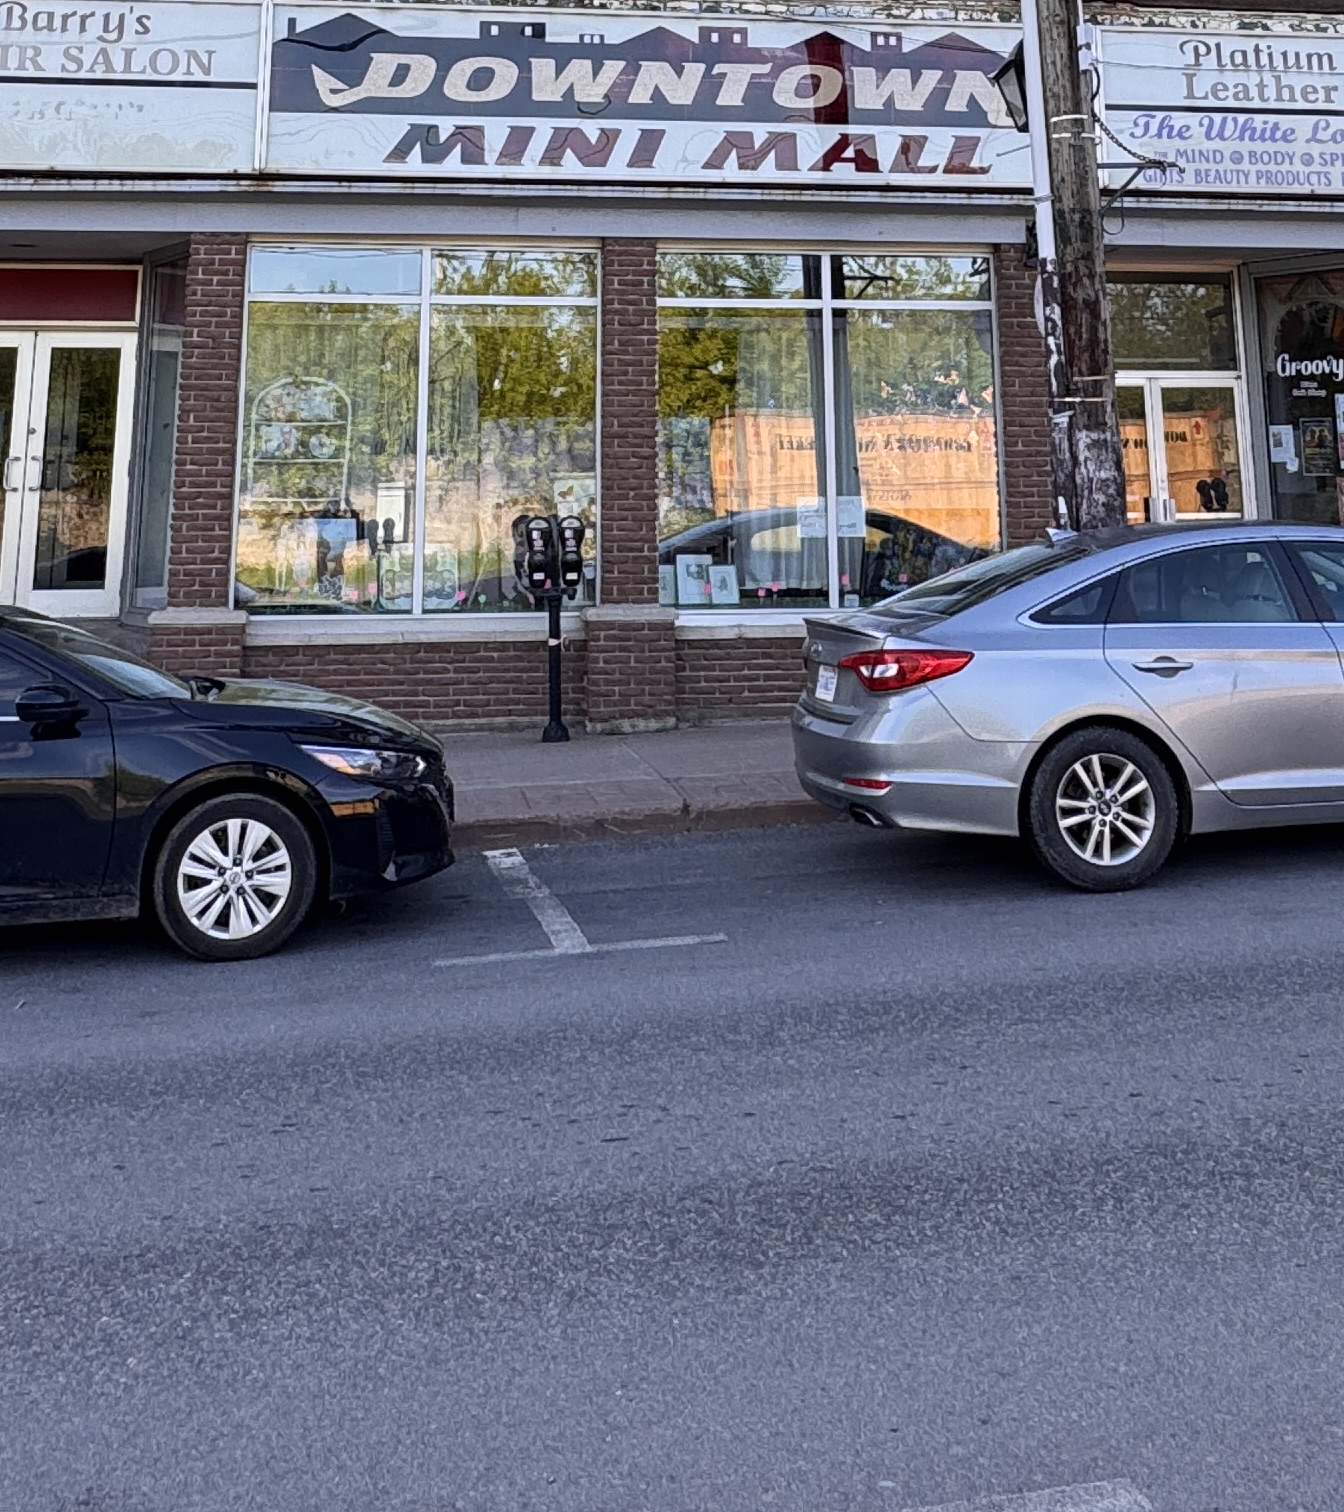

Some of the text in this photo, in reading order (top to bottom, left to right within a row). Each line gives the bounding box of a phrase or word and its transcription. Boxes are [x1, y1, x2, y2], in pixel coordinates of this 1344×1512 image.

[60, 45, 217, 77] SALON
[1178, 39, 1338, 72] Platium
[311, 51, 1016, 128] DOWNTOWN
[1181, 71, 1339, 104] Leather
[1128, 113, 1194, 141] The
[1198, 114, 1298, 145] White
[382, 122, 994, 175] MINI MALL
[1174, 148, 1225, 165] MIND
[1248, 150, 1296, 166] BODY
[1194, 168, 1251, 186] BEAUTY
[1256, 169, 1332, 188] PRODUCTS
[1276, 353, 1344, 382] Groovy
